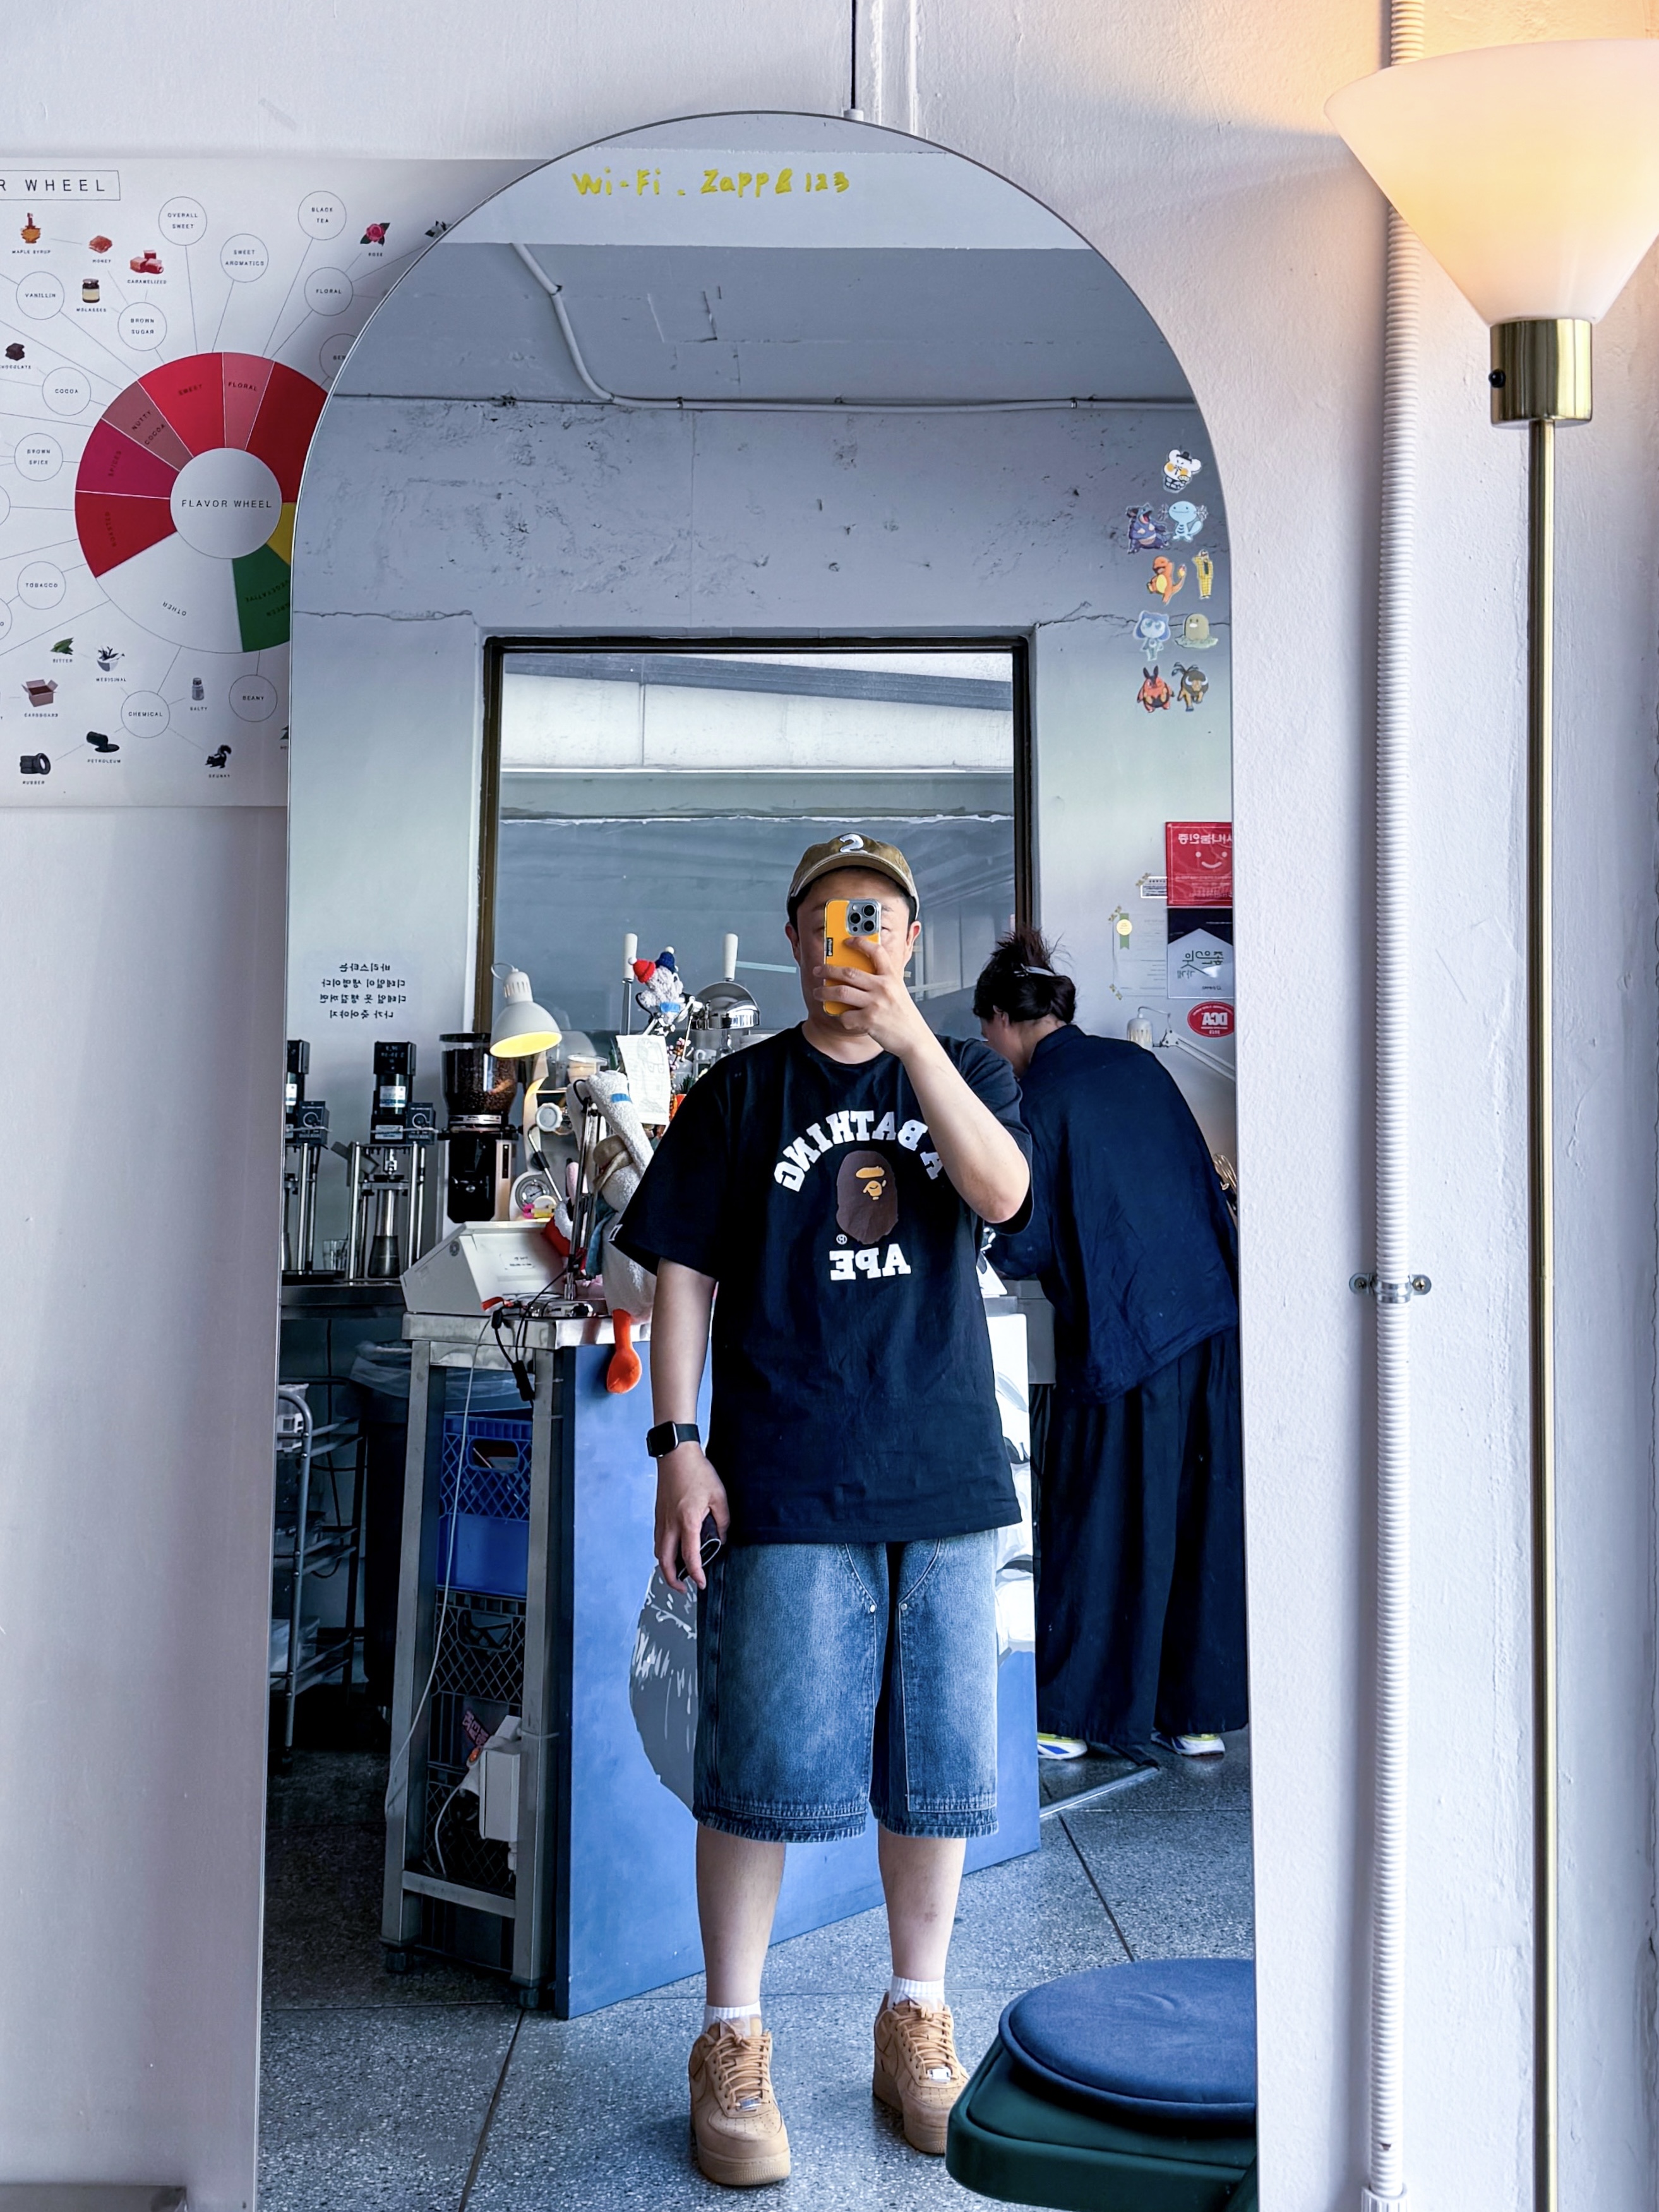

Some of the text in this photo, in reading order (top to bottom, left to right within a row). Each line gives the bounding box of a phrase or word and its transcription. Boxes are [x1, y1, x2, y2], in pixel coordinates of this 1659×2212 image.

[25, 179, 105, 191] WHEEL
[572, 166, 661, 196] Wi-Fi
[178, 383, 203, 396] SWEET
[228, 381, 258, 392] FLORAL
[131, 410, 152, 432] NUTTY
[145, 423, 166, 445] COCOA
[108, 450, 122, 477] SPICES
[181, 499, 272, 508] FLAVOR WHEEL
[162, 601, 187, 616] OTHER
